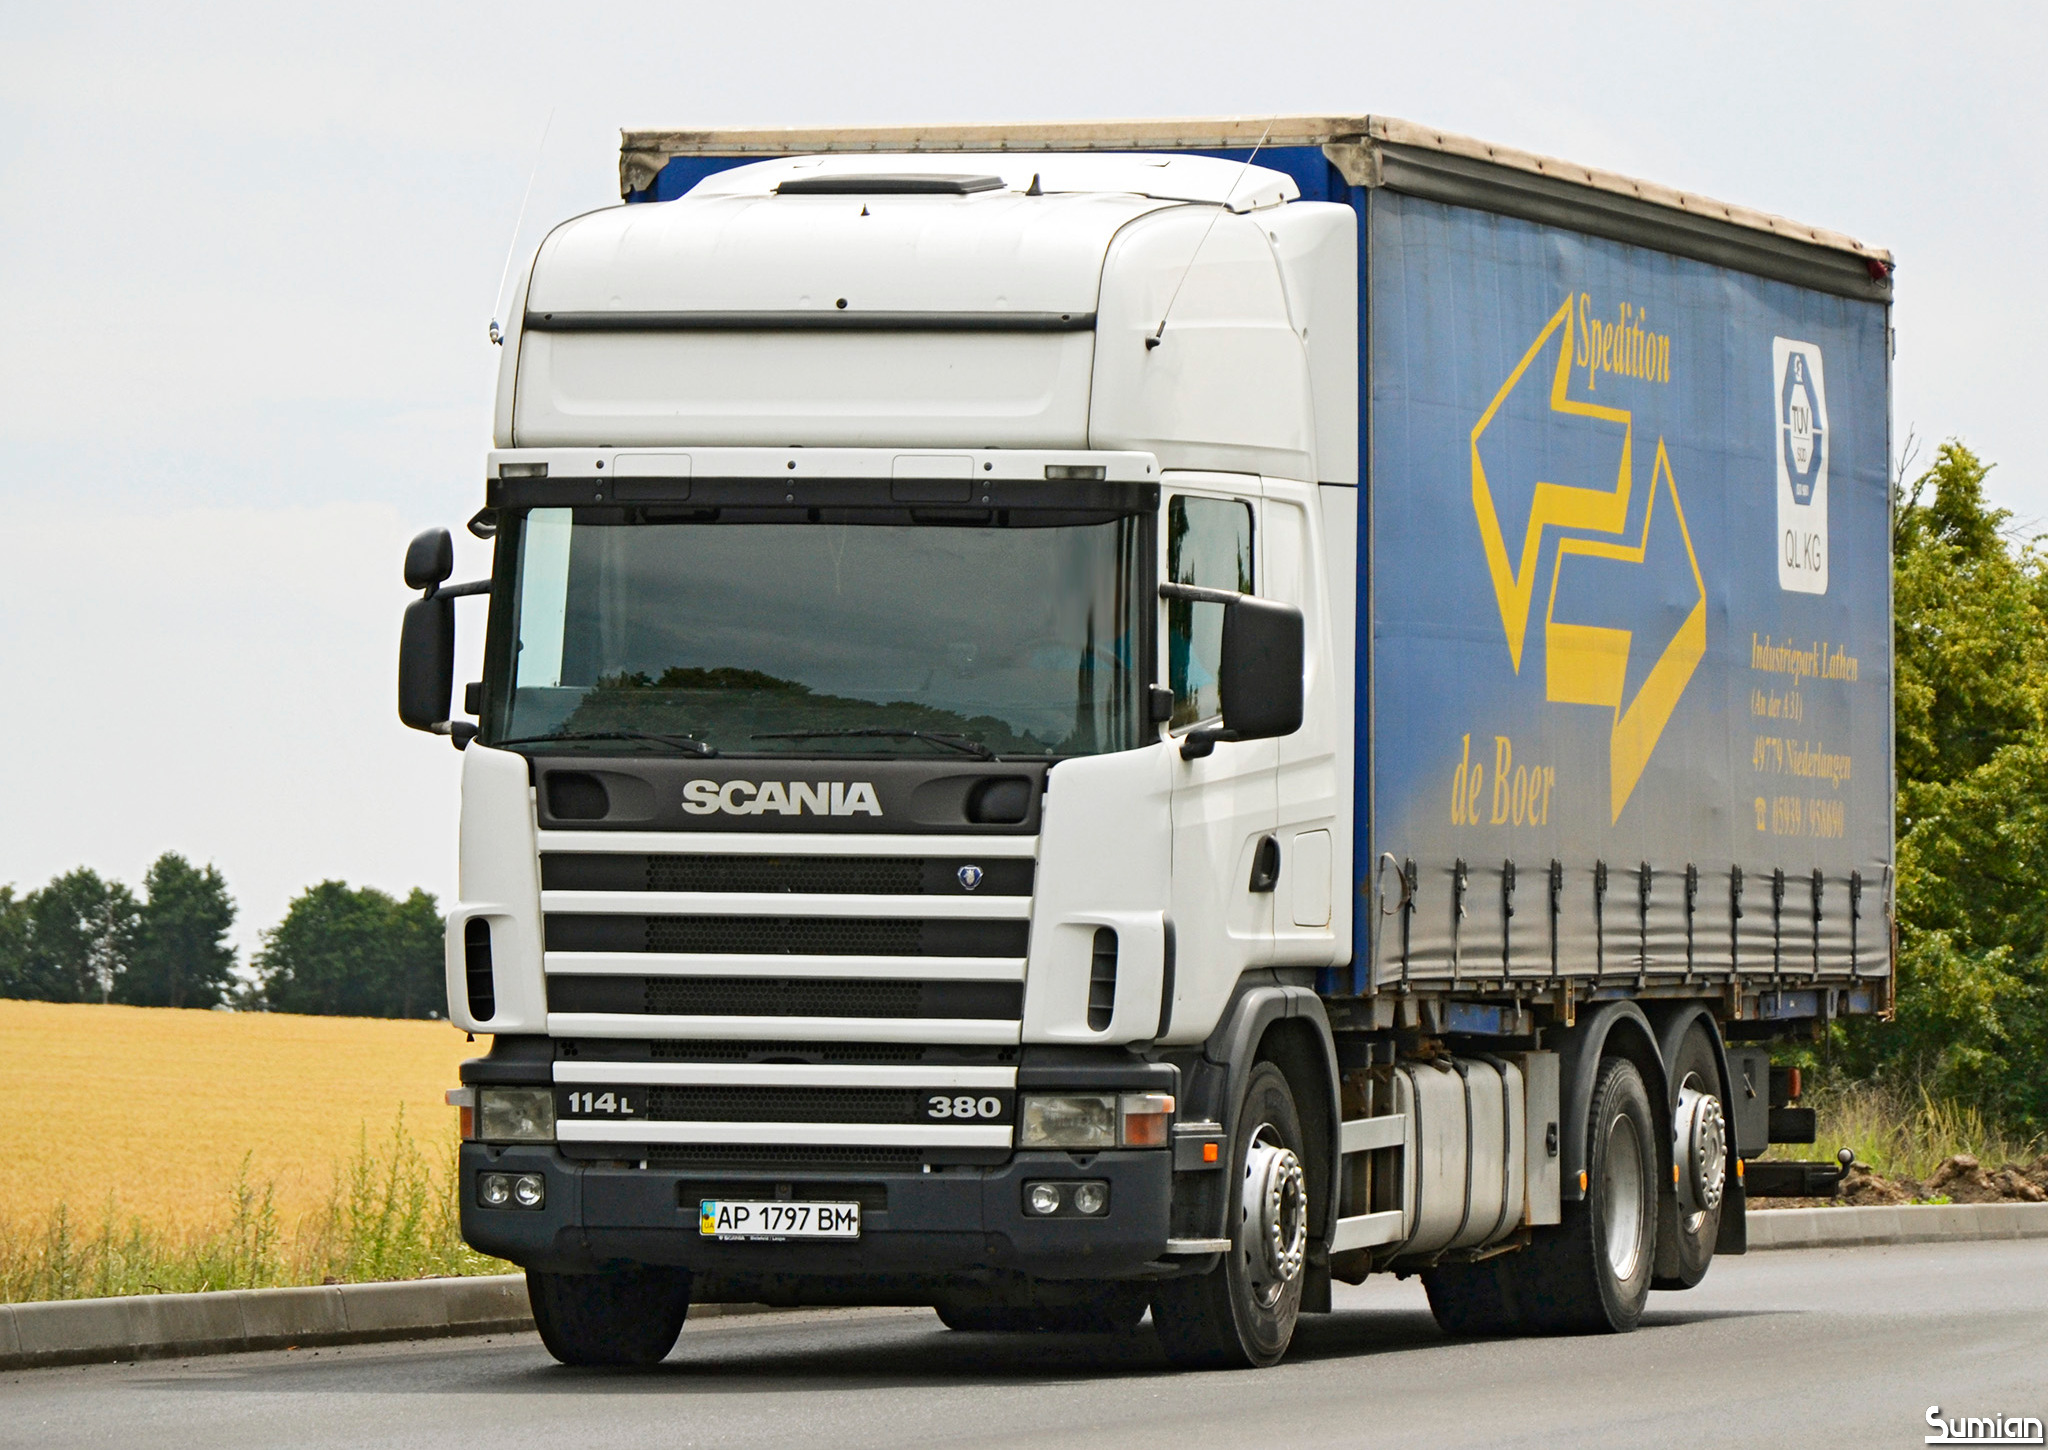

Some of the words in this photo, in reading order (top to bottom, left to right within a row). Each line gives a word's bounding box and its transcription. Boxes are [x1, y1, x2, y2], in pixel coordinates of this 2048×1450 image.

[1577, 292, 1671, 392] Spedition
[1785, 529, 1801, 570] QL
[1804, 531, 1821, 572] KG
[1751, 632, 1819, 686] Industriepark
[1822, 642, 1858, 682] Lathen
[1451, 733, 1483, 827] de
[1493, 735, 1556, 827] Boer
[1784, 738, 1851, 790] Niederlangen
[682, 779, 883, 817] SCANIA
[928, 1096, 1002, 1119] 380
[717, 1206, 750, 1230] AP
[759, 1207, 811, 1230] 1797
[818, 1208, 853, 1231] BM
